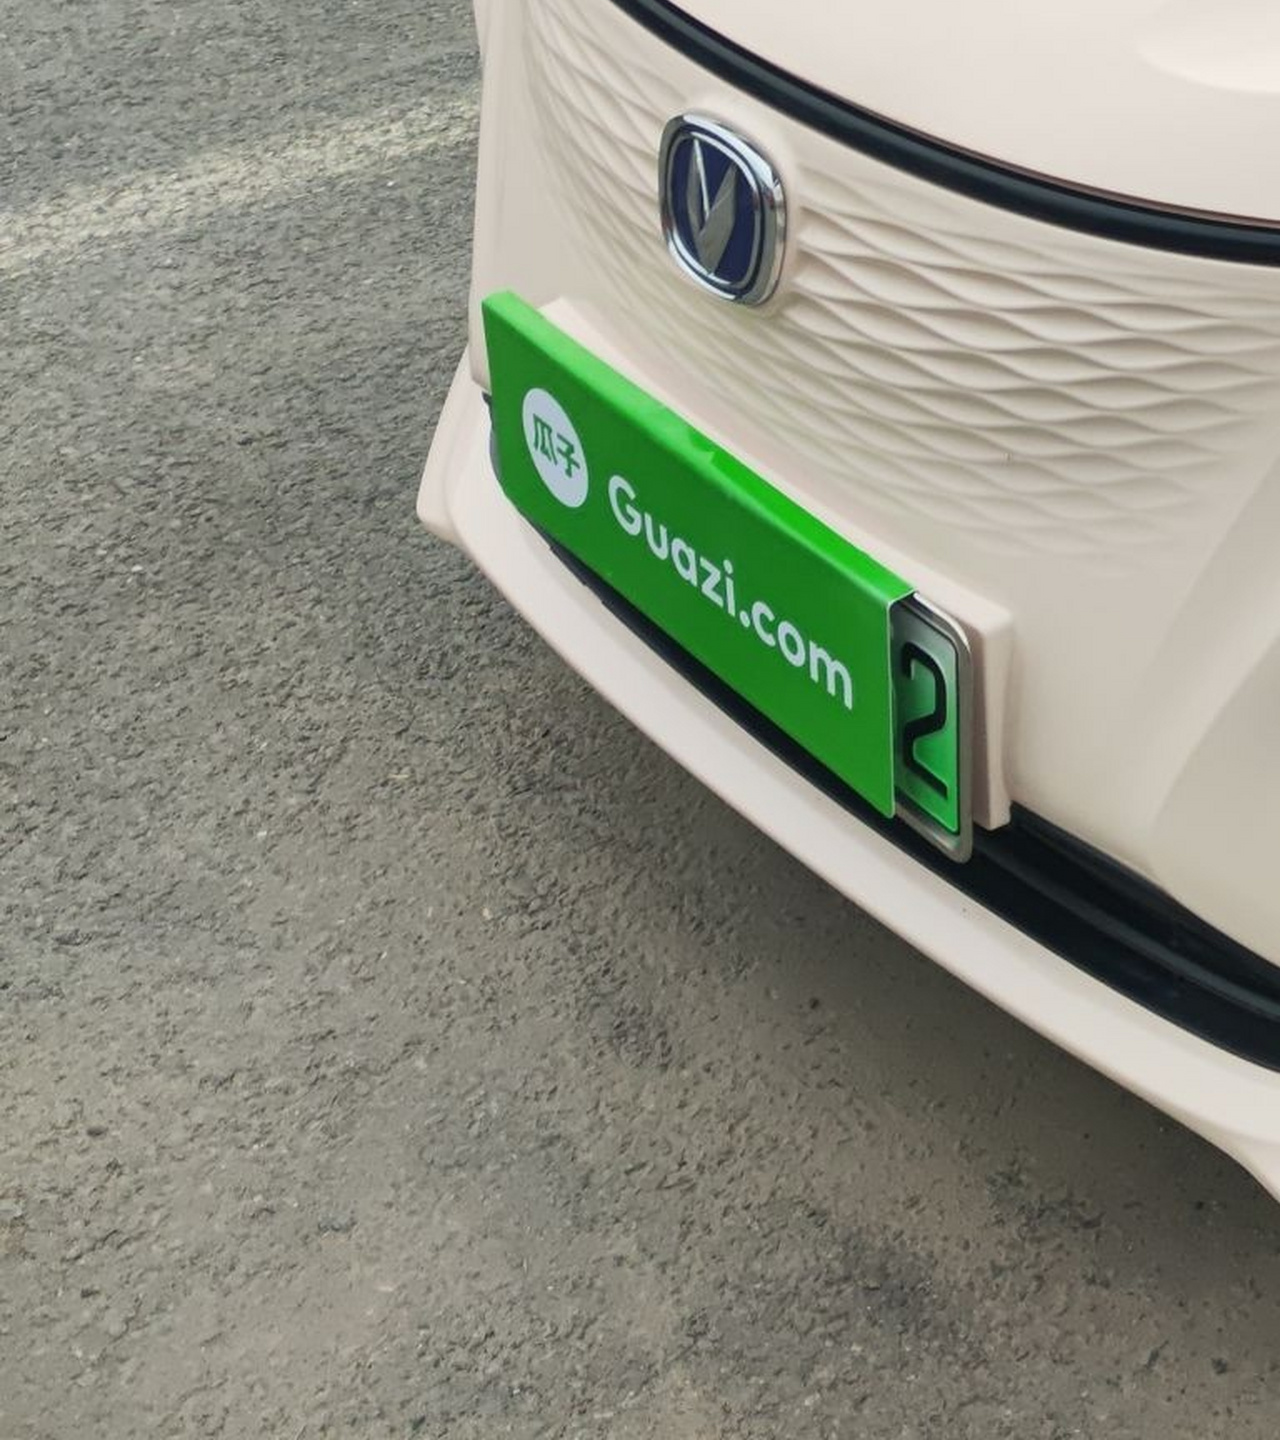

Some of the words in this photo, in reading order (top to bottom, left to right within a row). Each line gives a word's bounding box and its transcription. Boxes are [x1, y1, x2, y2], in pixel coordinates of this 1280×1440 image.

[532, 413, 581, 478] 瓜子
[608, 474, 852, 711] Guazi.com
[901, 641, 948, 801] 2
